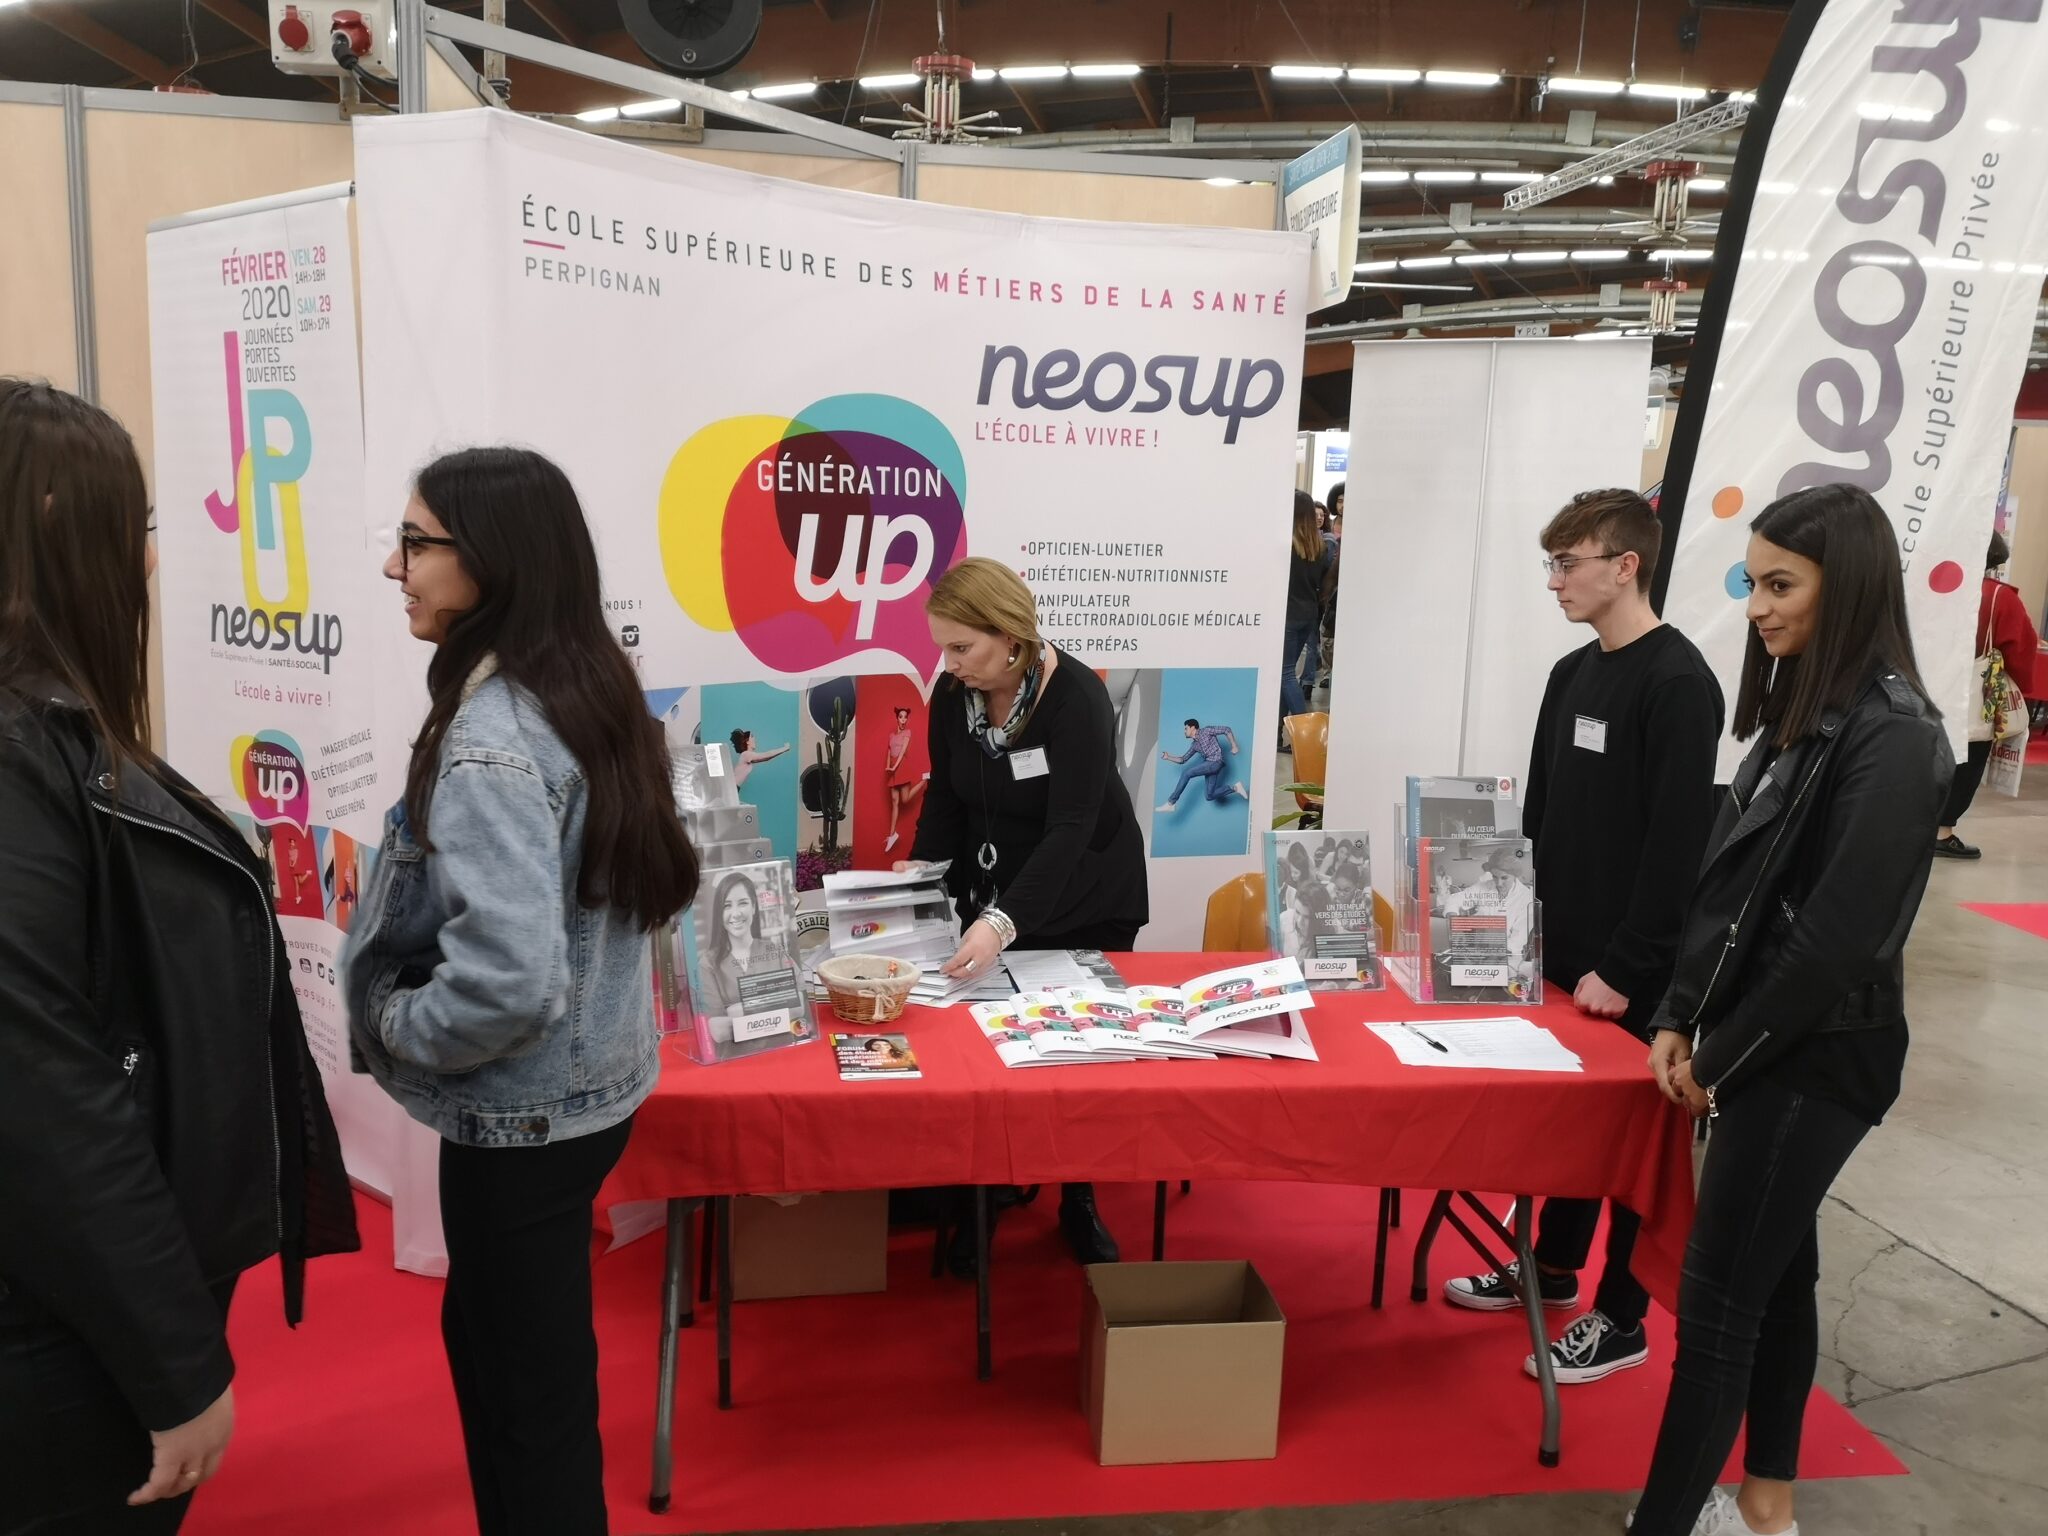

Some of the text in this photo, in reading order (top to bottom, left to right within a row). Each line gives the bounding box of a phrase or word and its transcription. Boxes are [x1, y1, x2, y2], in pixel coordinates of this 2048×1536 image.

[292, 246, 326, 266] VEN.28
[522, 194, 1286, 316] ÉCOLE SUPÉRIEURE DES MÉTIERS DE LA SANTÉ
[222, 248, 288, 286] FÉVRIER
[295, 269, 326, 284] 14H>18H
[525, 257, 662, 297] PERPIGNAN
[242, 285, 291, 320] 2020
[297, 295, 332, 314] SAM.29
[1913, 280, 1974, 470] Supérieure
[1953, 151, 2000, 260] Privée
[244, 323, 294, 346] JOURNÉES
[245, 347, 280, 364] PORTES
[246, 366, 296, 383] OUVERTES
[976, 344, 1285, 445] neosup
[975, 417, 1056, 445] L'ÉCOLE
[1064, 421, 1077, 446] À
[1086, 426, 1146, 448] VIVRE
[757, 452, 942, 498] GÉNÉRATION
[1028, 541, 1164, 557] OPTICIEN-LUNETIER
[793, 513, 935, 640] up
[1027, 564, 1229, 583] DIÉTÉTICIEN-NUTRITIONNISTE
[1048, 610, 1190, 627] ÉLECTRORADIOLOGIE
[1194, 610, 1262, 626] MÉDICALE
[211, 603, 342, 674] neosup
[1087, 635, 1138, 651] PRÉPAS
[235, 679, 271, 701] L'école
[275, 685, 283, 702] à
[287, 688, 322, 706] vivre
[248, 749, 297, 768] GÉNÉRATION
[258, 767, 299, 814] up
[1315, 962, 1347, 972] neosup
[1464, 968, 1499, 978] neosup
[1215, 1002, 1281, 1022] neosup
[747, 1016, 781, 1031] neosup
